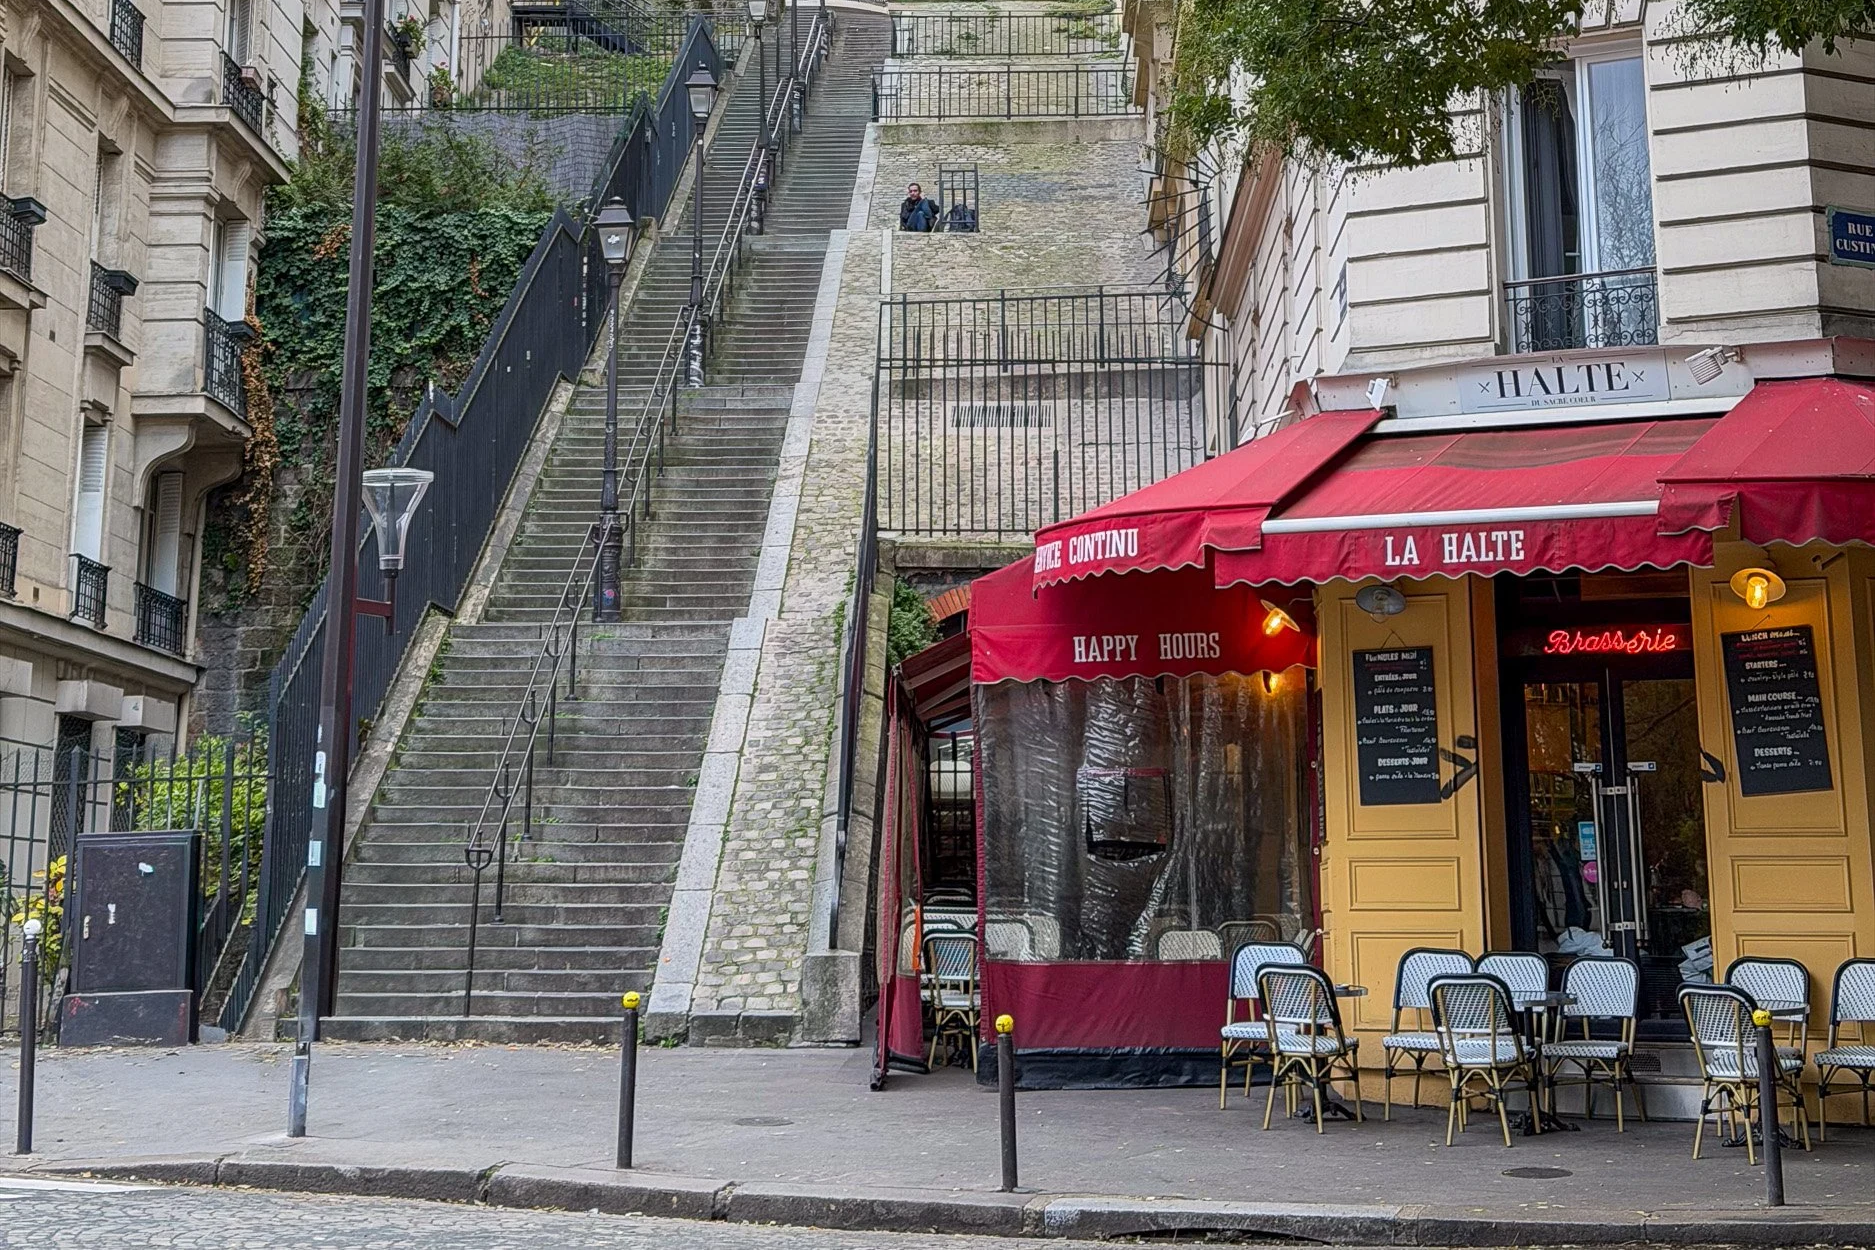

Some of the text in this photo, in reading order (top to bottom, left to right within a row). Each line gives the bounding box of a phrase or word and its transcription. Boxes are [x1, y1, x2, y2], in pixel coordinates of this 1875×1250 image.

[1848, 222, 1873, 237] RUE
[1552, 356, 1564, 364] LA
[1494, 362, 1630, 399] HALTE
[1068, 528, 1139, 564] CONTINU
[1384, 530, 1525, 566] LA HALTE
[1073, 632, 1220, 663] HAPPY HOURS
[1544, 628, 1676, 654] Brasserie
[1748, 693, 1767, 702] MAIN
[1768, 692, 1796, 700] COURSE
[1374, 705, 1394, 714] PLATS
[1400, 704, 1418, 712] JOUR
[1754, 747, 1792, 757] DESSERTS
[1378, 757, 1428, 766] DESSERTS JOUR
